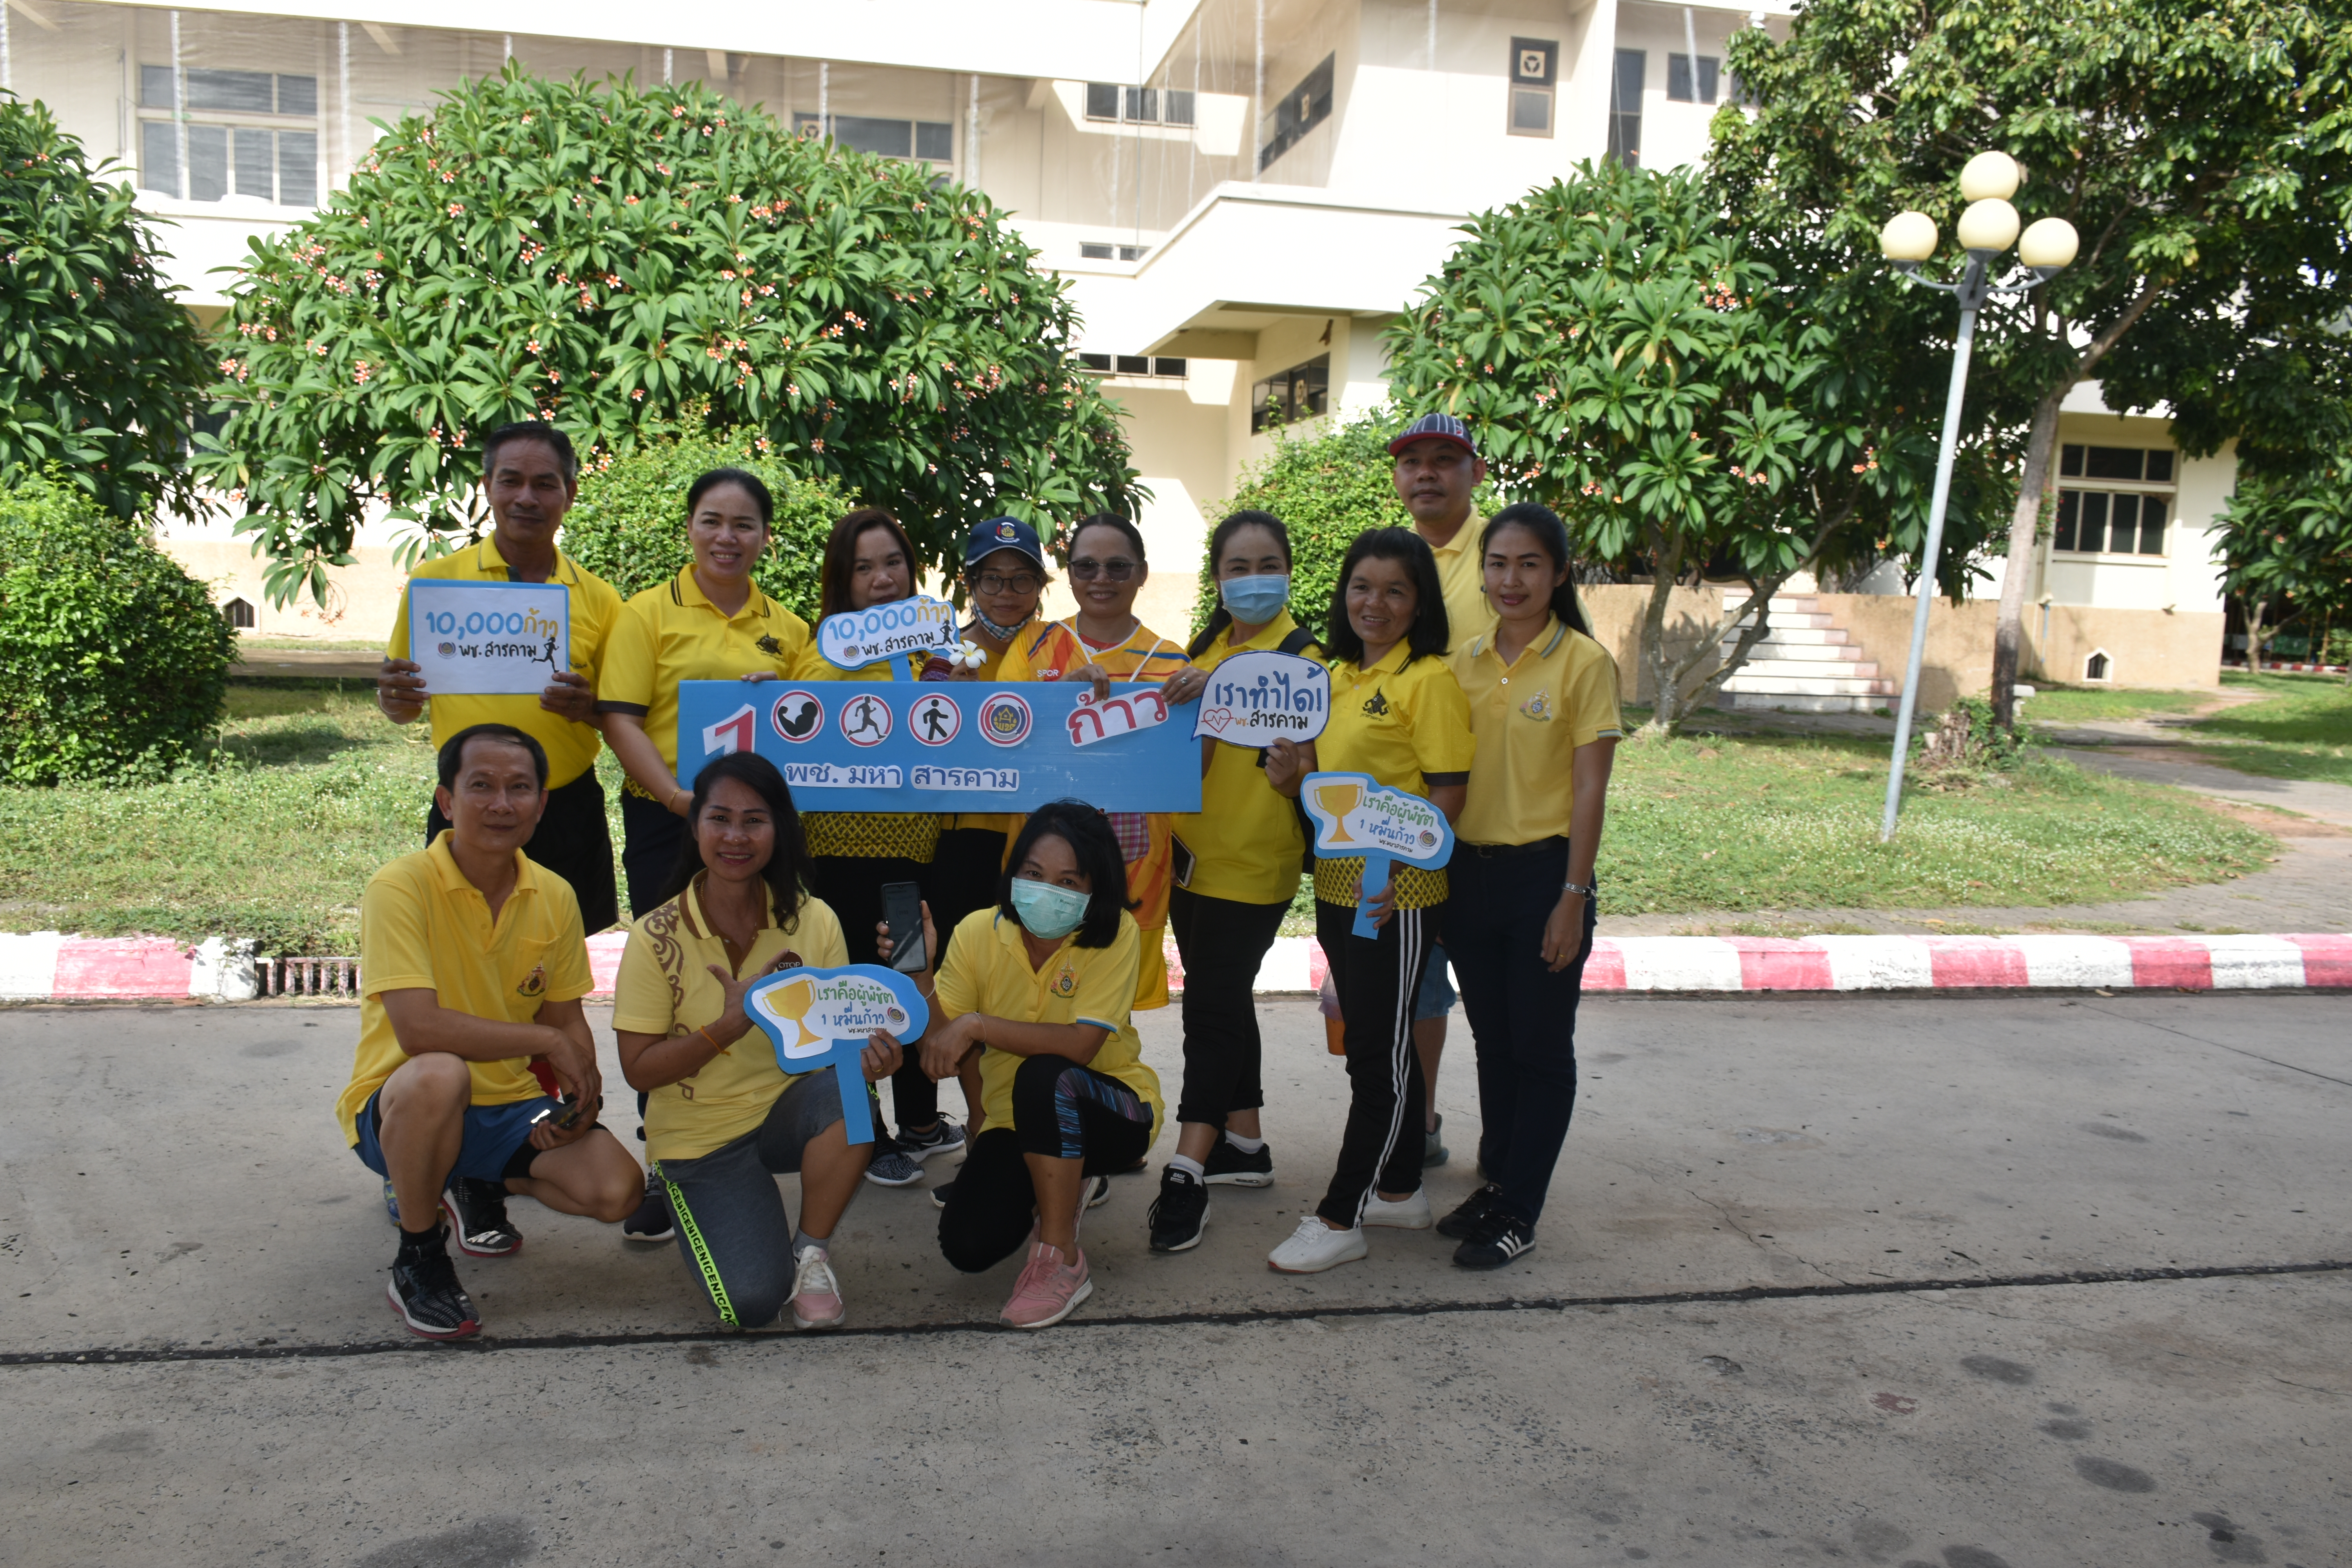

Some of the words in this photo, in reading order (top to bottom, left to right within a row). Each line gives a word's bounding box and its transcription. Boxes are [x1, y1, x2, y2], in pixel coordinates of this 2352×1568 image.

[1215, 666, 1323, 712] เราทำได้!
[1068, 691, 1167, 744] ก้าว
[914, 766, 1017, 788] สารคาม
[1363, 795, 1434, 828] เราคือผู้พิชิต
[818, 980, 894, 1006] เราคือผู้พิชิต
